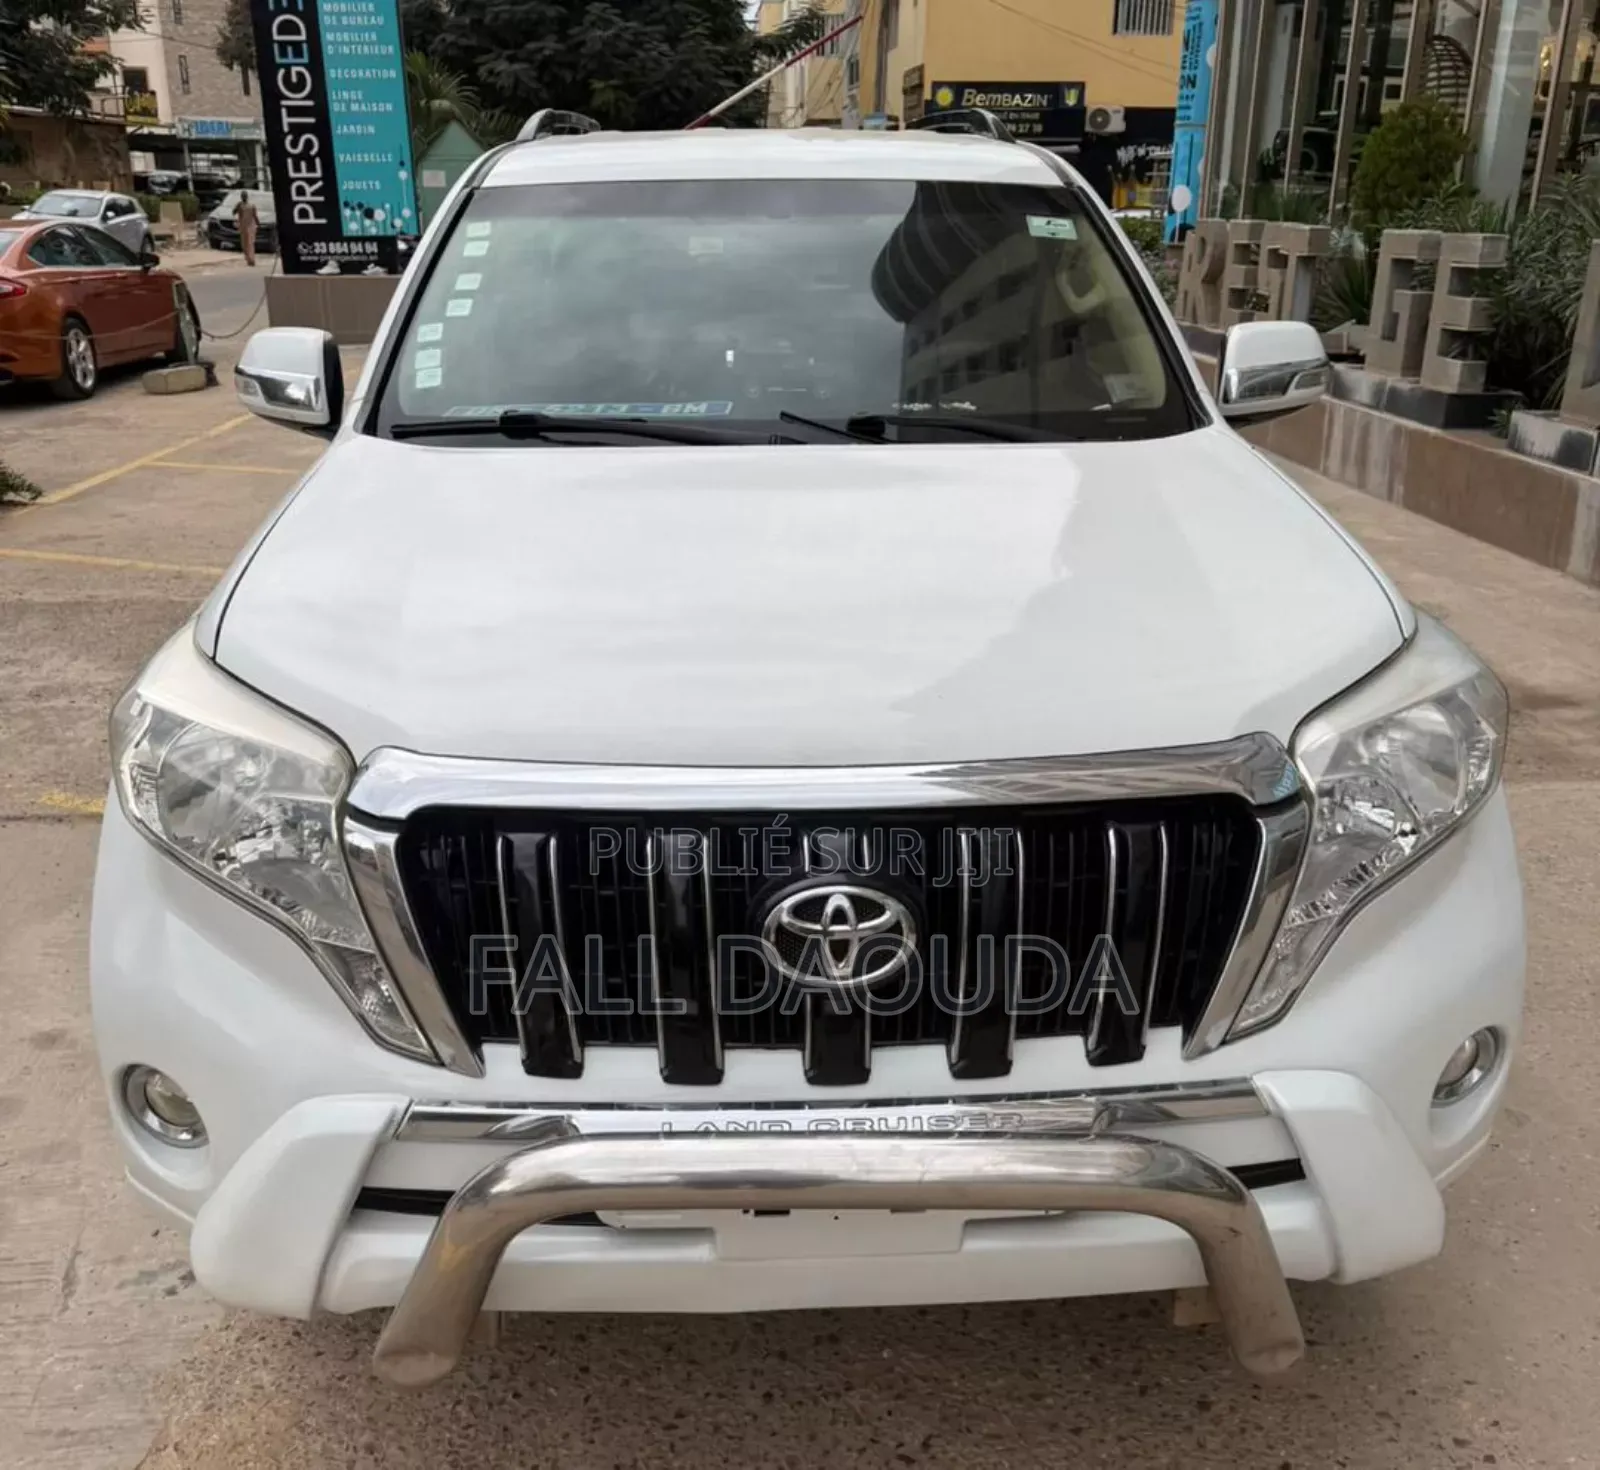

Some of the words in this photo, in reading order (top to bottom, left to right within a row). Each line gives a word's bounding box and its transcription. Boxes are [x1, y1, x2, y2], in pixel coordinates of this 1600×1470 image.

[323, 3, 376, 13] MOBILIER
[323, 15, 337, 25] DE
[341, 15, 385, 25] BUREAU
[325, 31, 378, 42] MOBILIER
[332, 90, 363, 100] LINGE
[333, 102, 347, 112] DE
[350, 102, 393, 112] MAISON
[336, 124, 376, 135] JARDIN
[338, 153, 393, 163] VAISSELLE
[342, 180, 381, 190] JOUETS
[806, 1111, 1024, 1132] CRUISER
